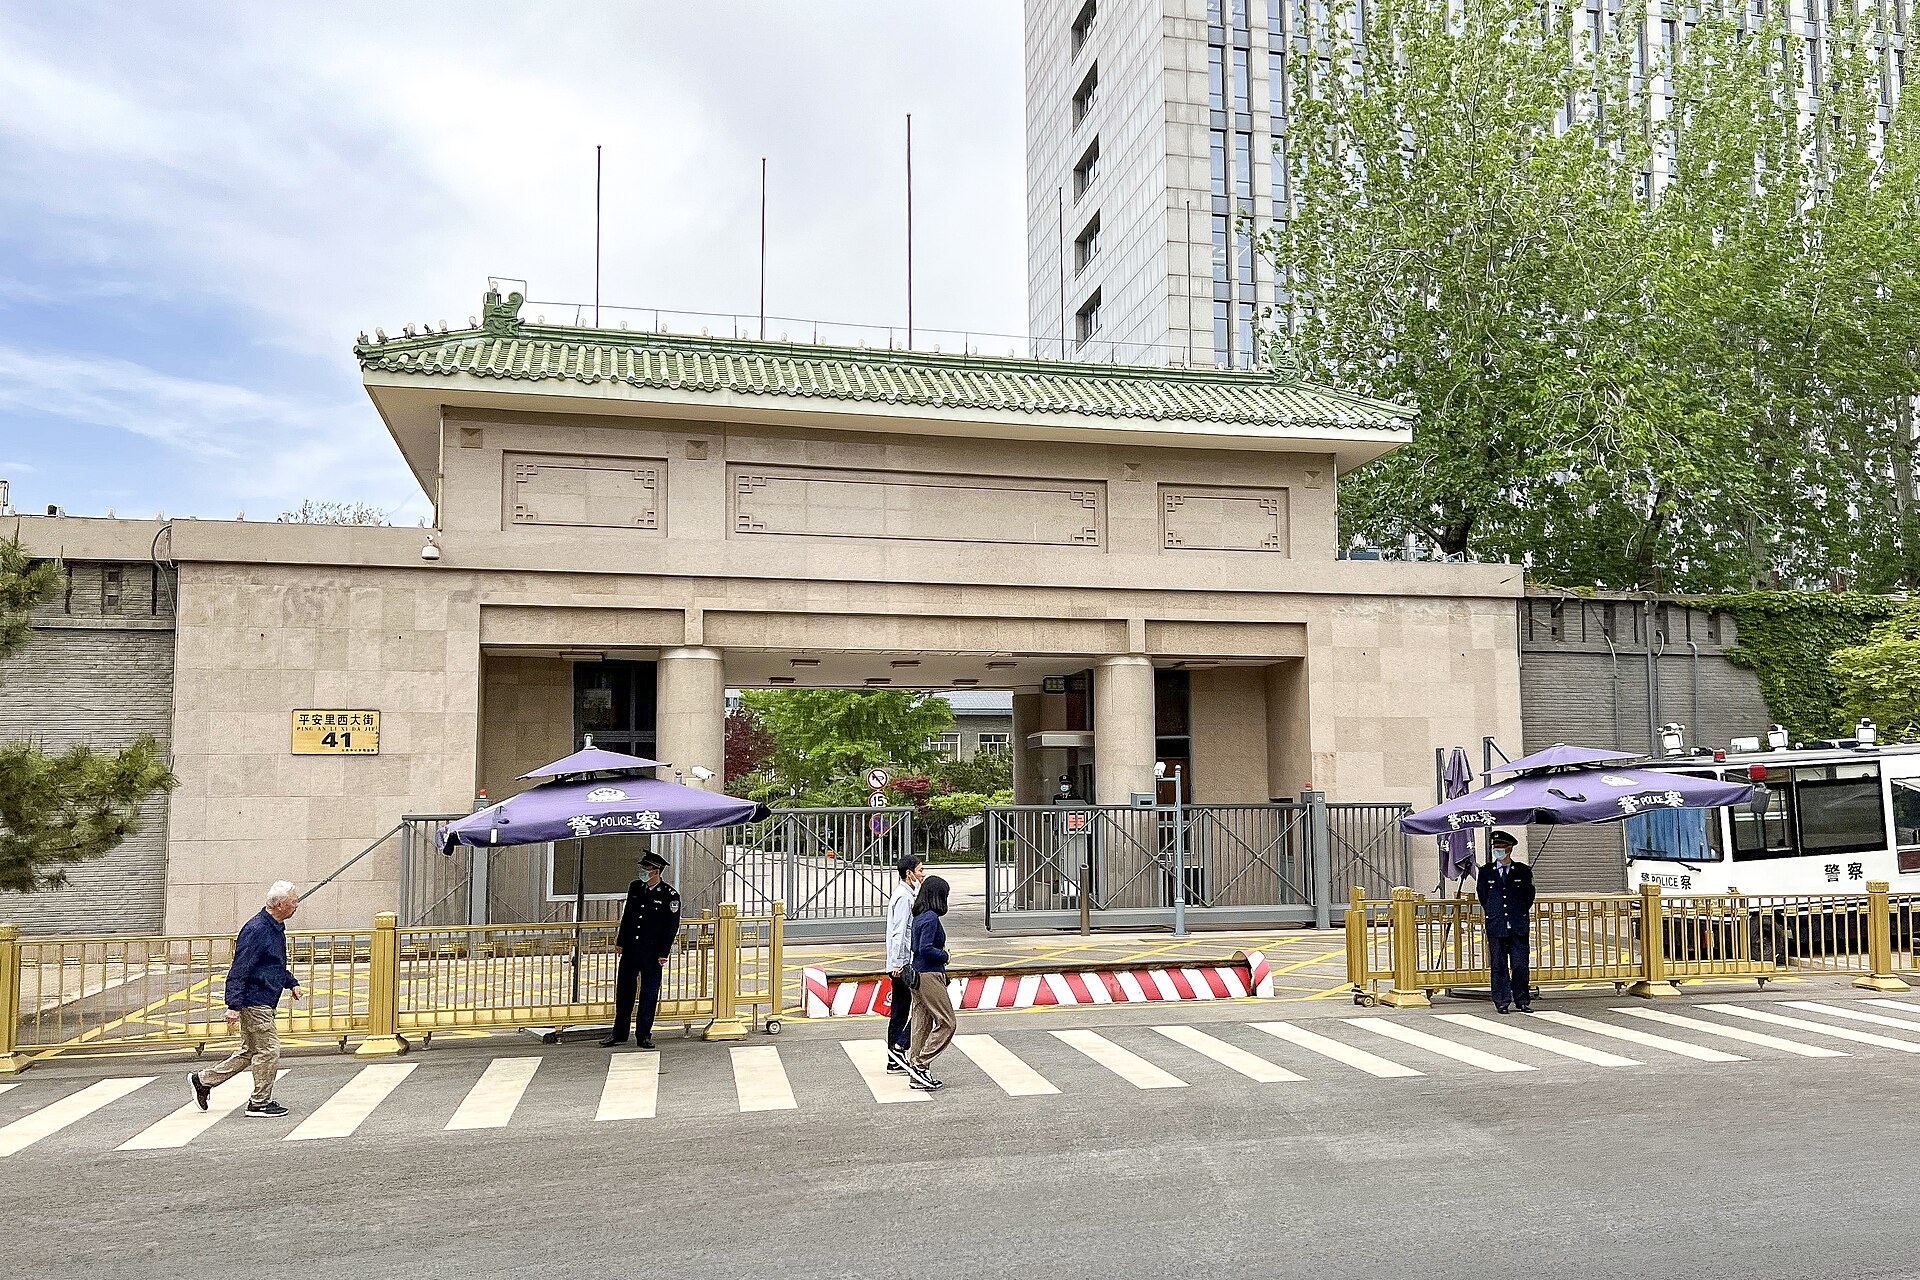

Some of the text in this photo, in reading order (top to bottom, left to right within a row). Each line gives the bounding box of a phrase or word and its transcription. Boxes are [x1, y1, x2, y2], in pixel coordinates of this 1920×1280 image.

[299, 714, 374, 726] 平安里西大街
[321, 732, 351, 748] 41
[873, 795, 884, 807] 15
[1617, 790, 1684, 813] 警 POLICE 察
[567, 810, 662, 836] 警 POLICE 察
[1477, 810, 1496, 825] 察
[1680, 875, 1691, 890] 察
